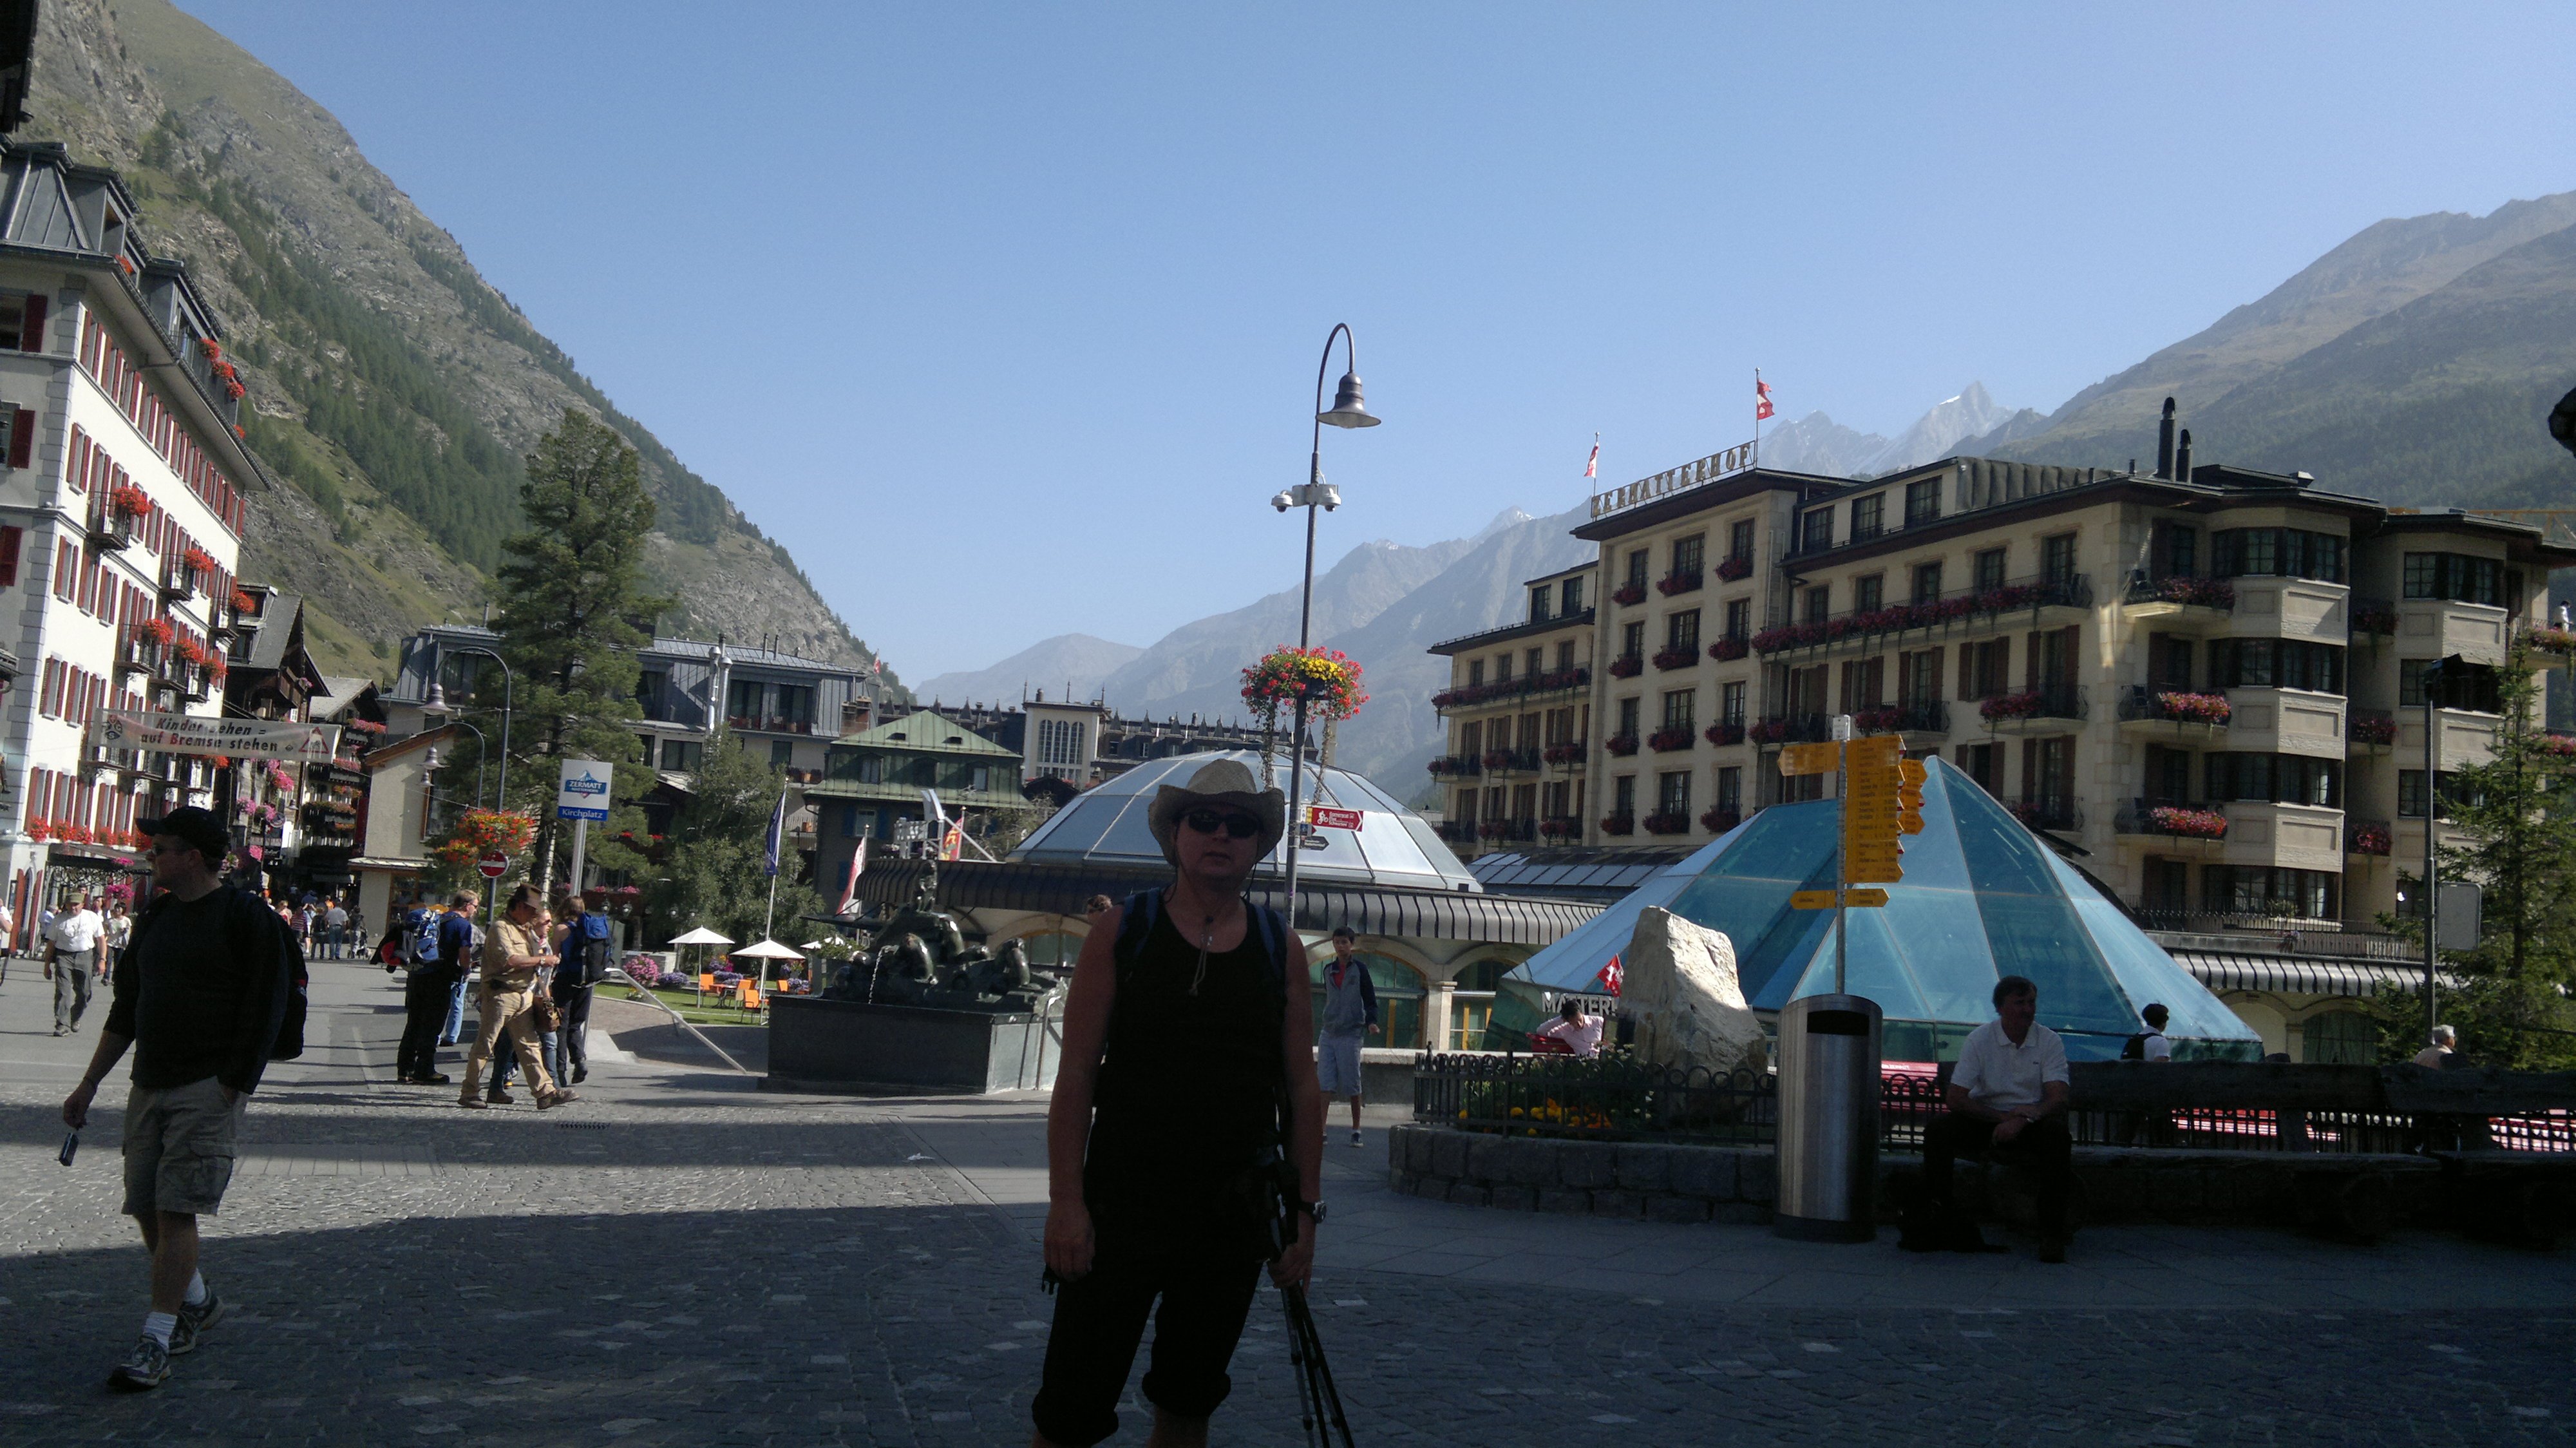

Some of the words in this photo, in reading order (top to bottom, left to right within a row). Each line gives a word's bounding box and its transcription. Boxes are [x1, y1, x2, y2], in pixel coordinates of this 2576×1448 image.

[1592, 443, 1751, 516] ZERMATTERHOF
[156, 718, 203, 732] Kinder
[141, 732, 164, 744] auf
[170, 733, 222, 748] Bremse
[230, 738, 278, 752] stehen
[569, 780, 602, 790] ZERMATT
[562, 808, 603, 820] Kirchplatz
